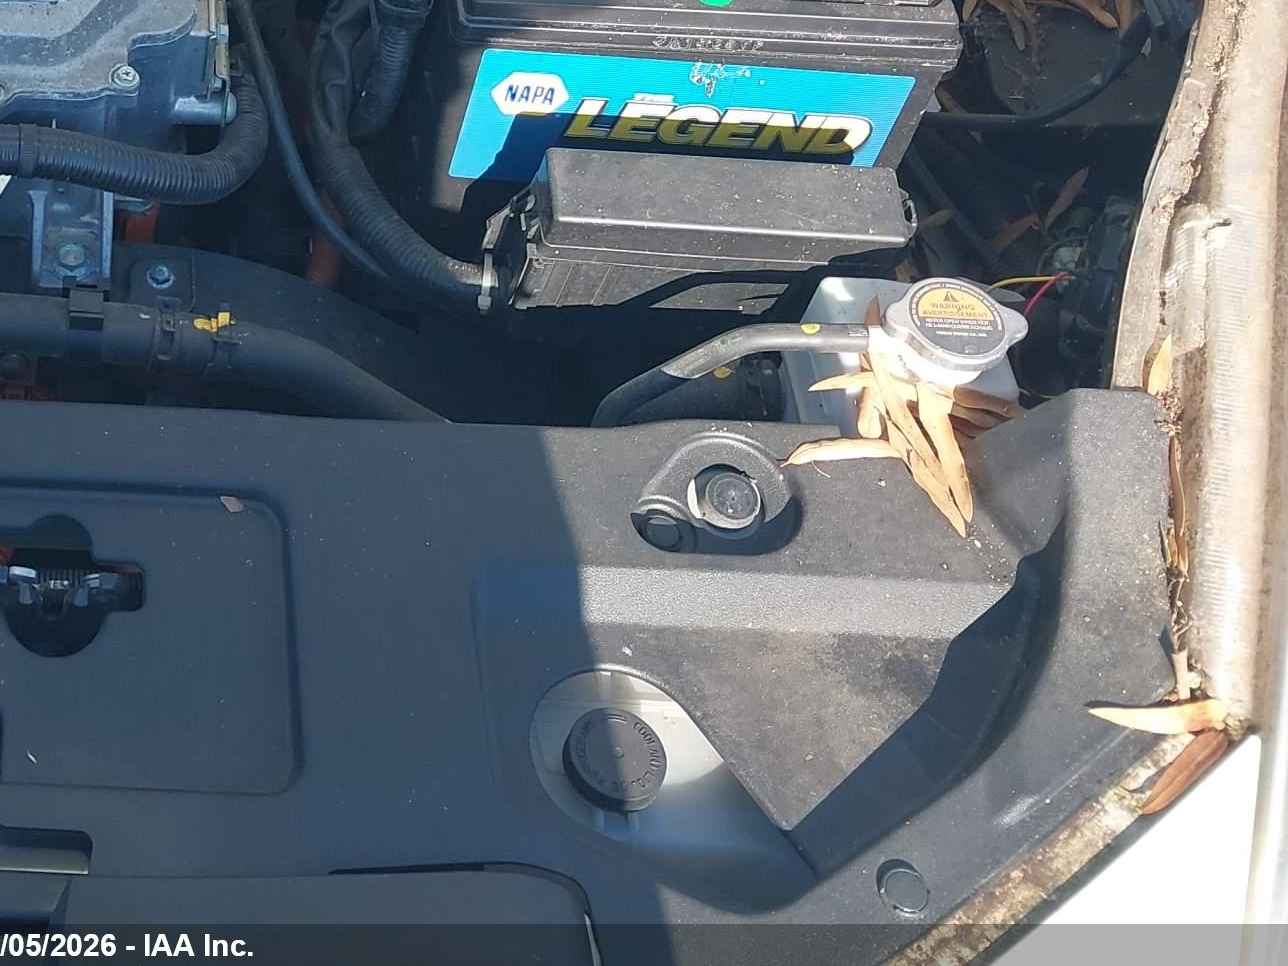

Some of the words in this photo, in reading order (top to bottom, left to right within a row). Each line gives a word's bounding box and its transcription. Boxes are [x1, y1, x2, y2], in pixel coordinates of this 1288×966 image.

[505, 84, 555, 105] NAPA
[564, 97, 872, 154] LEGEND
[931, 302, 975, 311] WARNING
